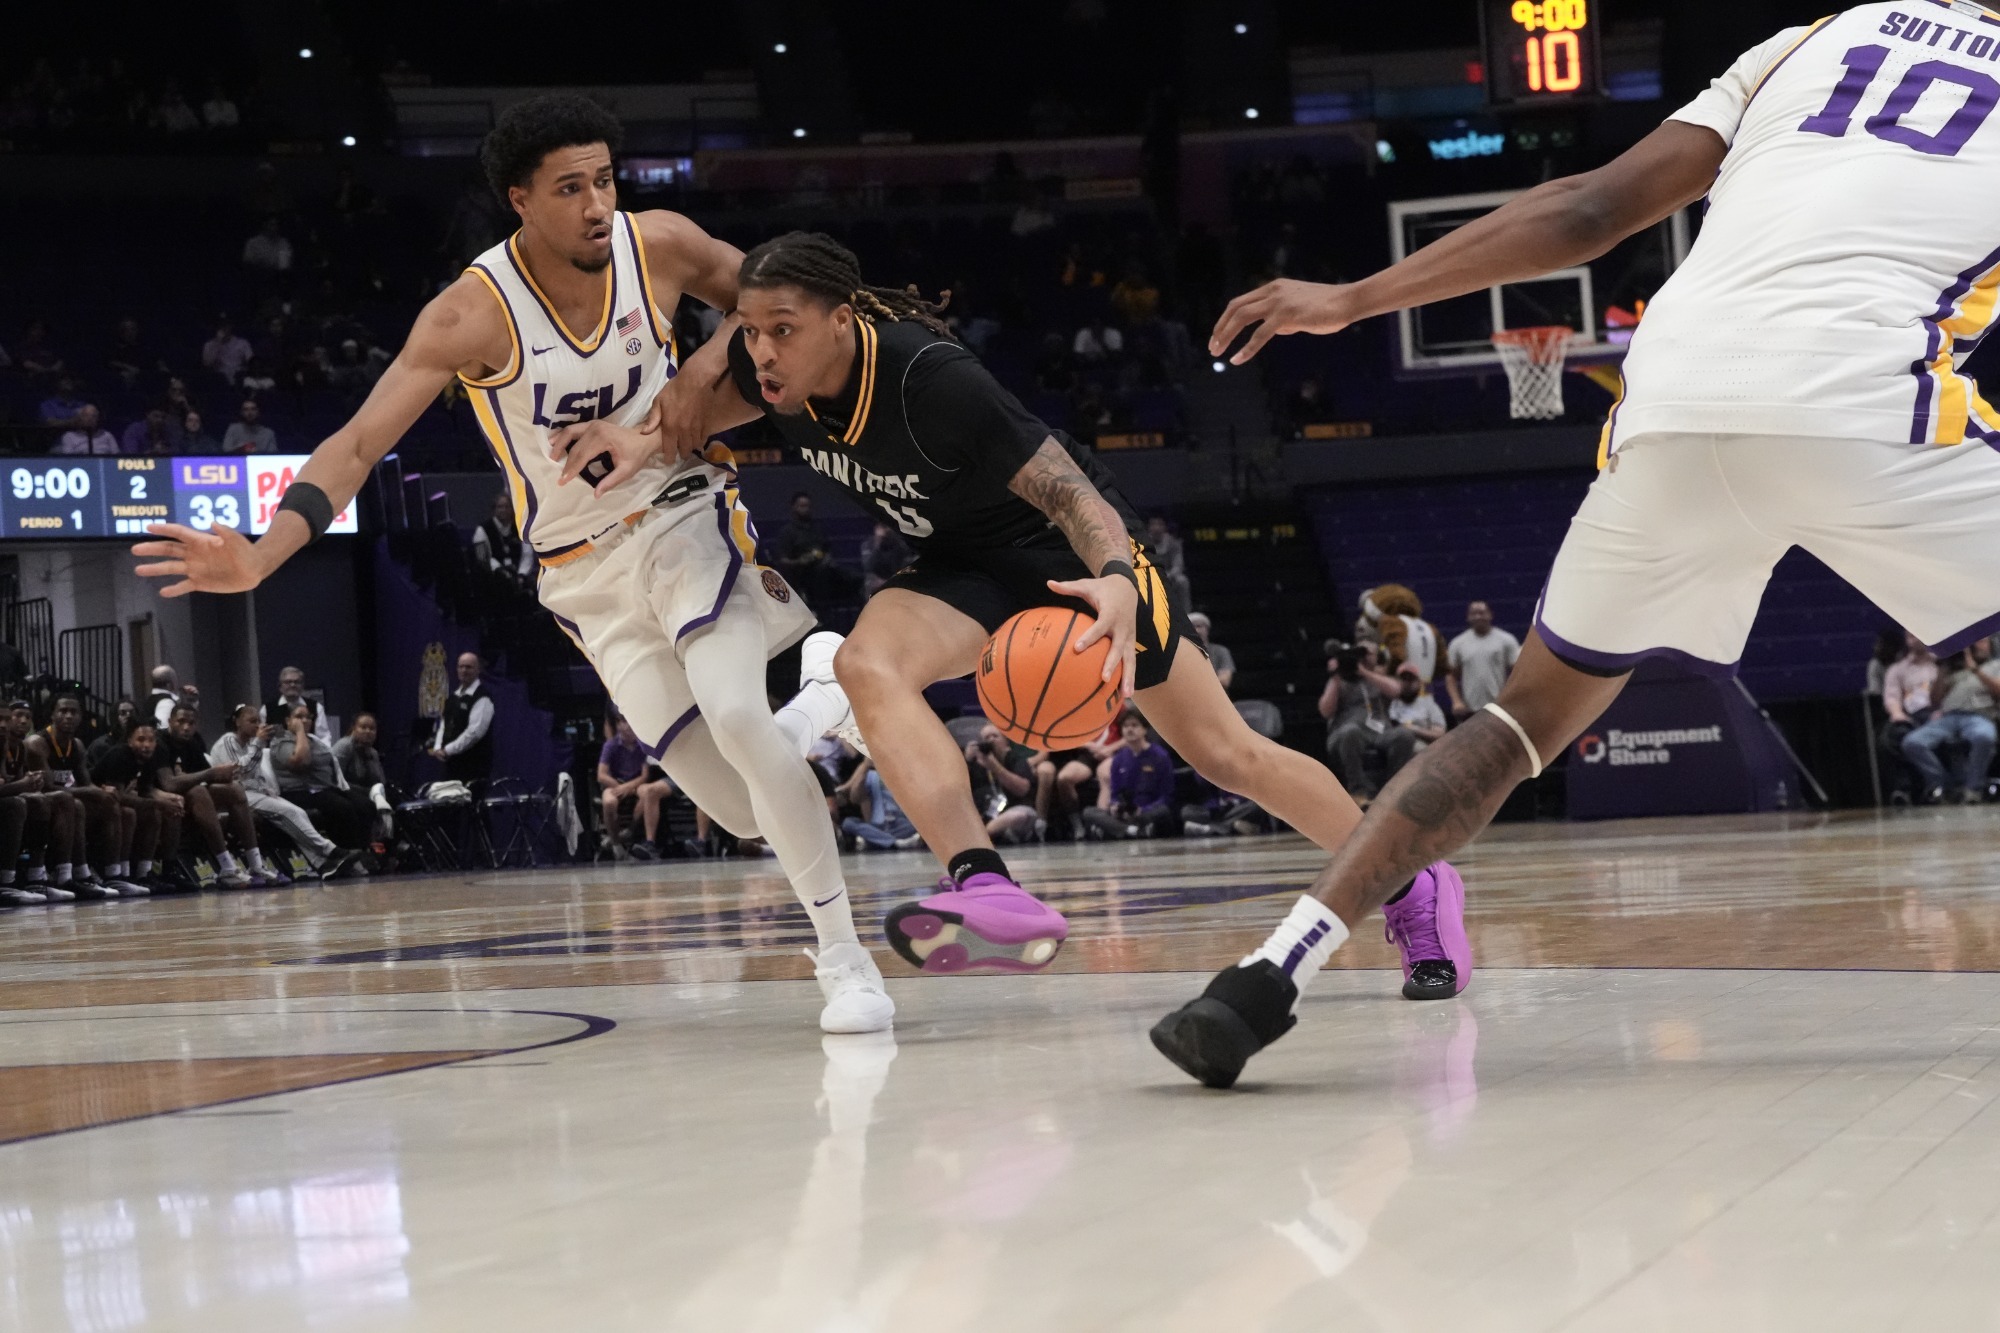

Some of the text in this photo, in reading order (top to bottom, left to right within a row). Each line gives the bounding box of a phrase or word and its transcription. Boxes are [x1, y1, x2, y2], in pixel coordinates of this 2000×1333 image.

[1511, 0, 1587, 31] 9:00
[1526, 31, 1581, 92] 10
[1797, 44, 2000, 157] 10
[627, 338, 641, 355] SEC
[533, 364, 642, 431] LSU
[117, 459, 156, 471] FOULS
[183, 464, 239, 485] LSU
[11, 468, 91, 499] 9:00
[130, 475, 147, 499] 2
[20, 509, 83, 530] PERIOD 1
[111, 505, 168, 517] TIMEOUTS
[189, 494, 241, 531] 33
[1607, 725, 1722, 749] Equipment
[1608, 749, 1670, 766] Share
